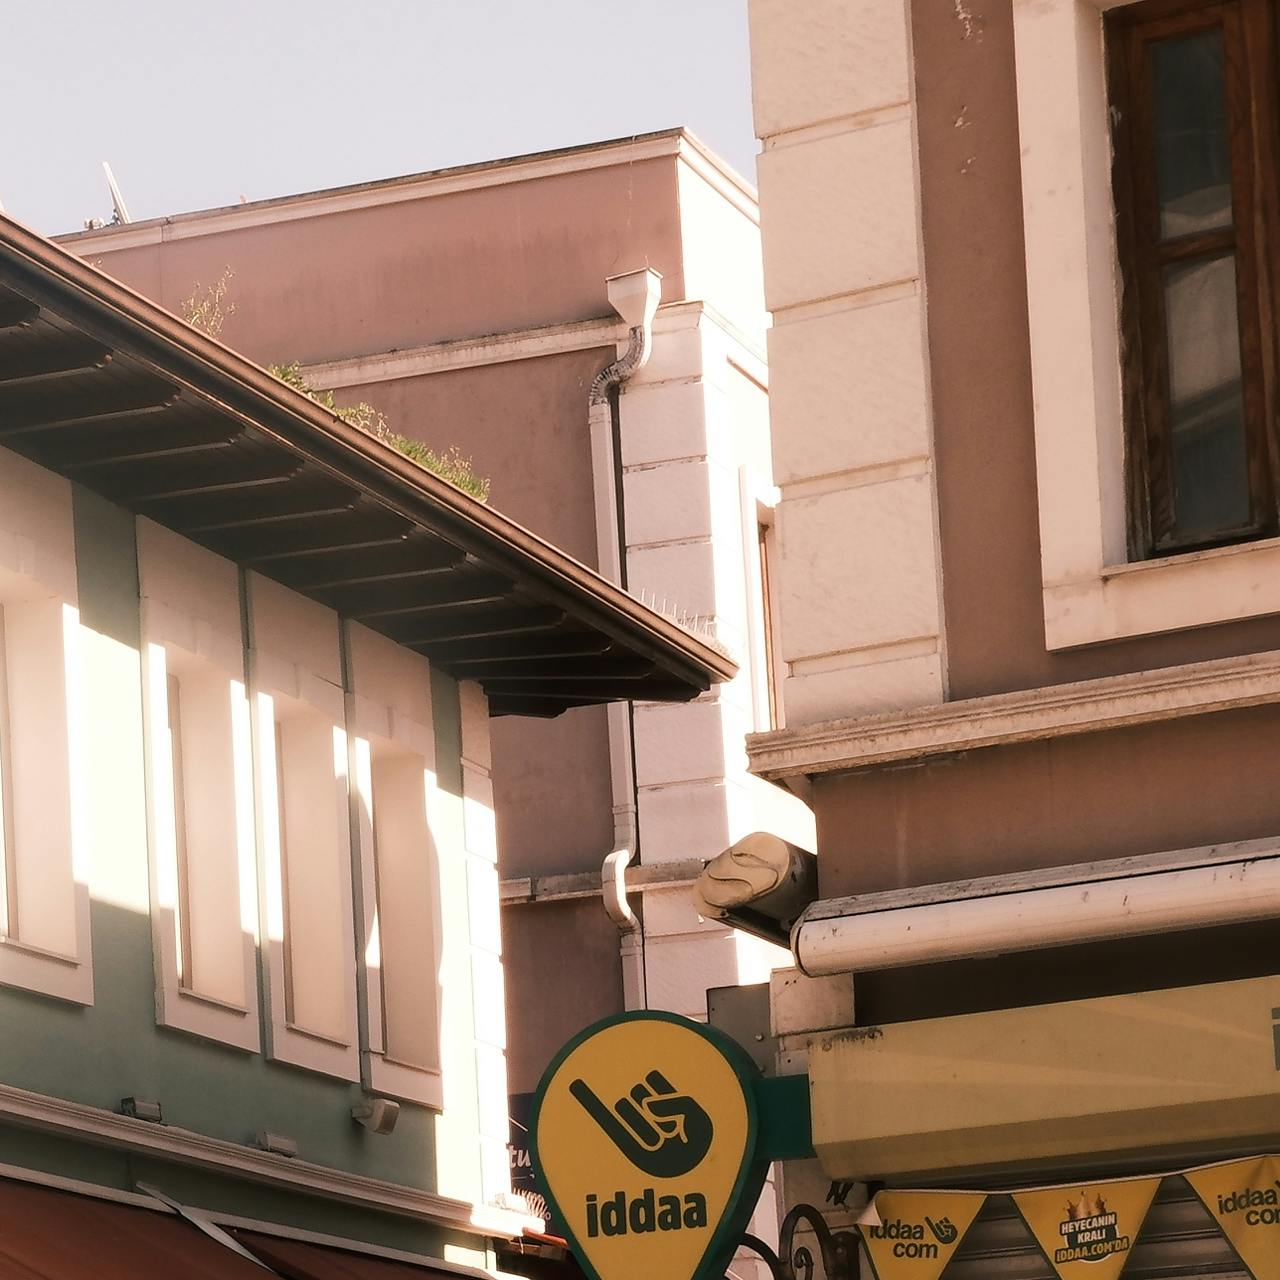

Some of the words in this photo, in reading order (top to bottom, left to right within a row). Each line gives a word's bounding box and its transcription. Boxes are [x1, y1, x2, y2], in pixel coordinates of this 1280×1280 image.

[1218, 1188, 1278, 1215] iddaa
[586, 1188, 707, 1238] iddaa
[1061, 1214, 1116, 1234] HEYECANIN
[1077, 1229, 1106, 1244] KRALI
[893, 1242, 938, 1258] com
